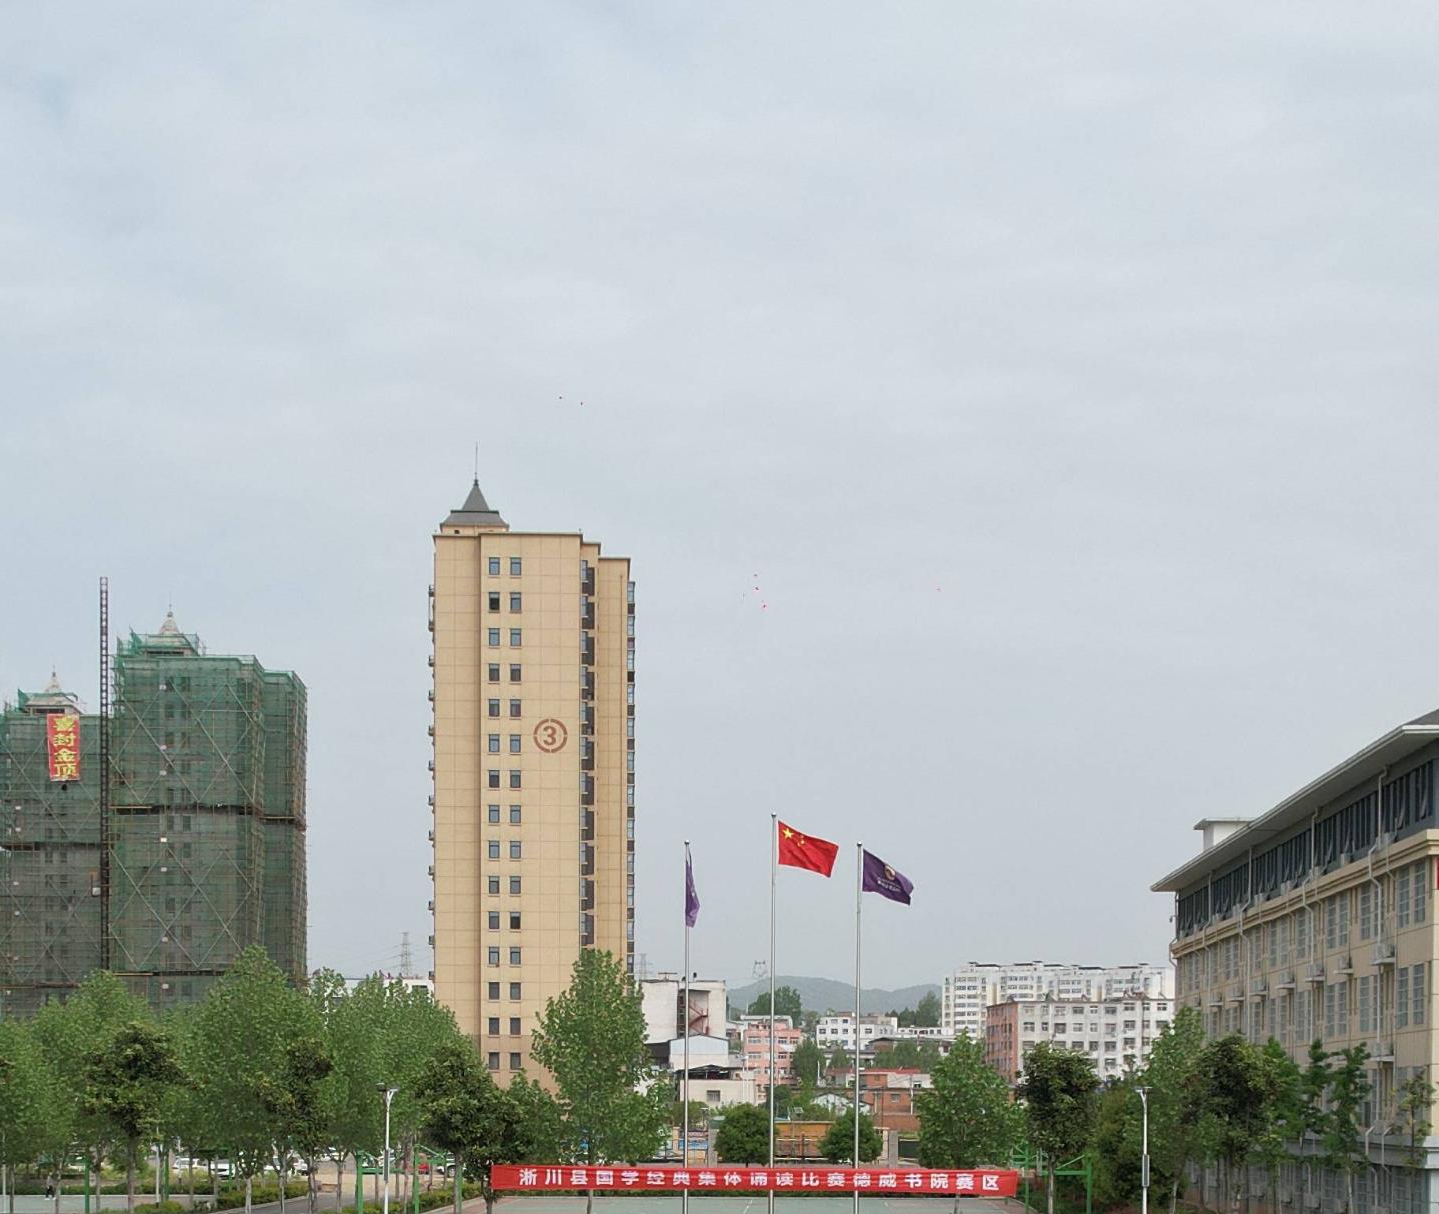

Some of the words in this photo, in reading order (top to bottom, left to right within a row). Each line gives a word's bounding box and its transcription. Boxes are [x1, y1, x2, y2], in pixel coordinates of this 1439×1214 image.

[519, 1168, 1000, 1192] 淅川县国学经典集体诵读比赛德威书院赛区
